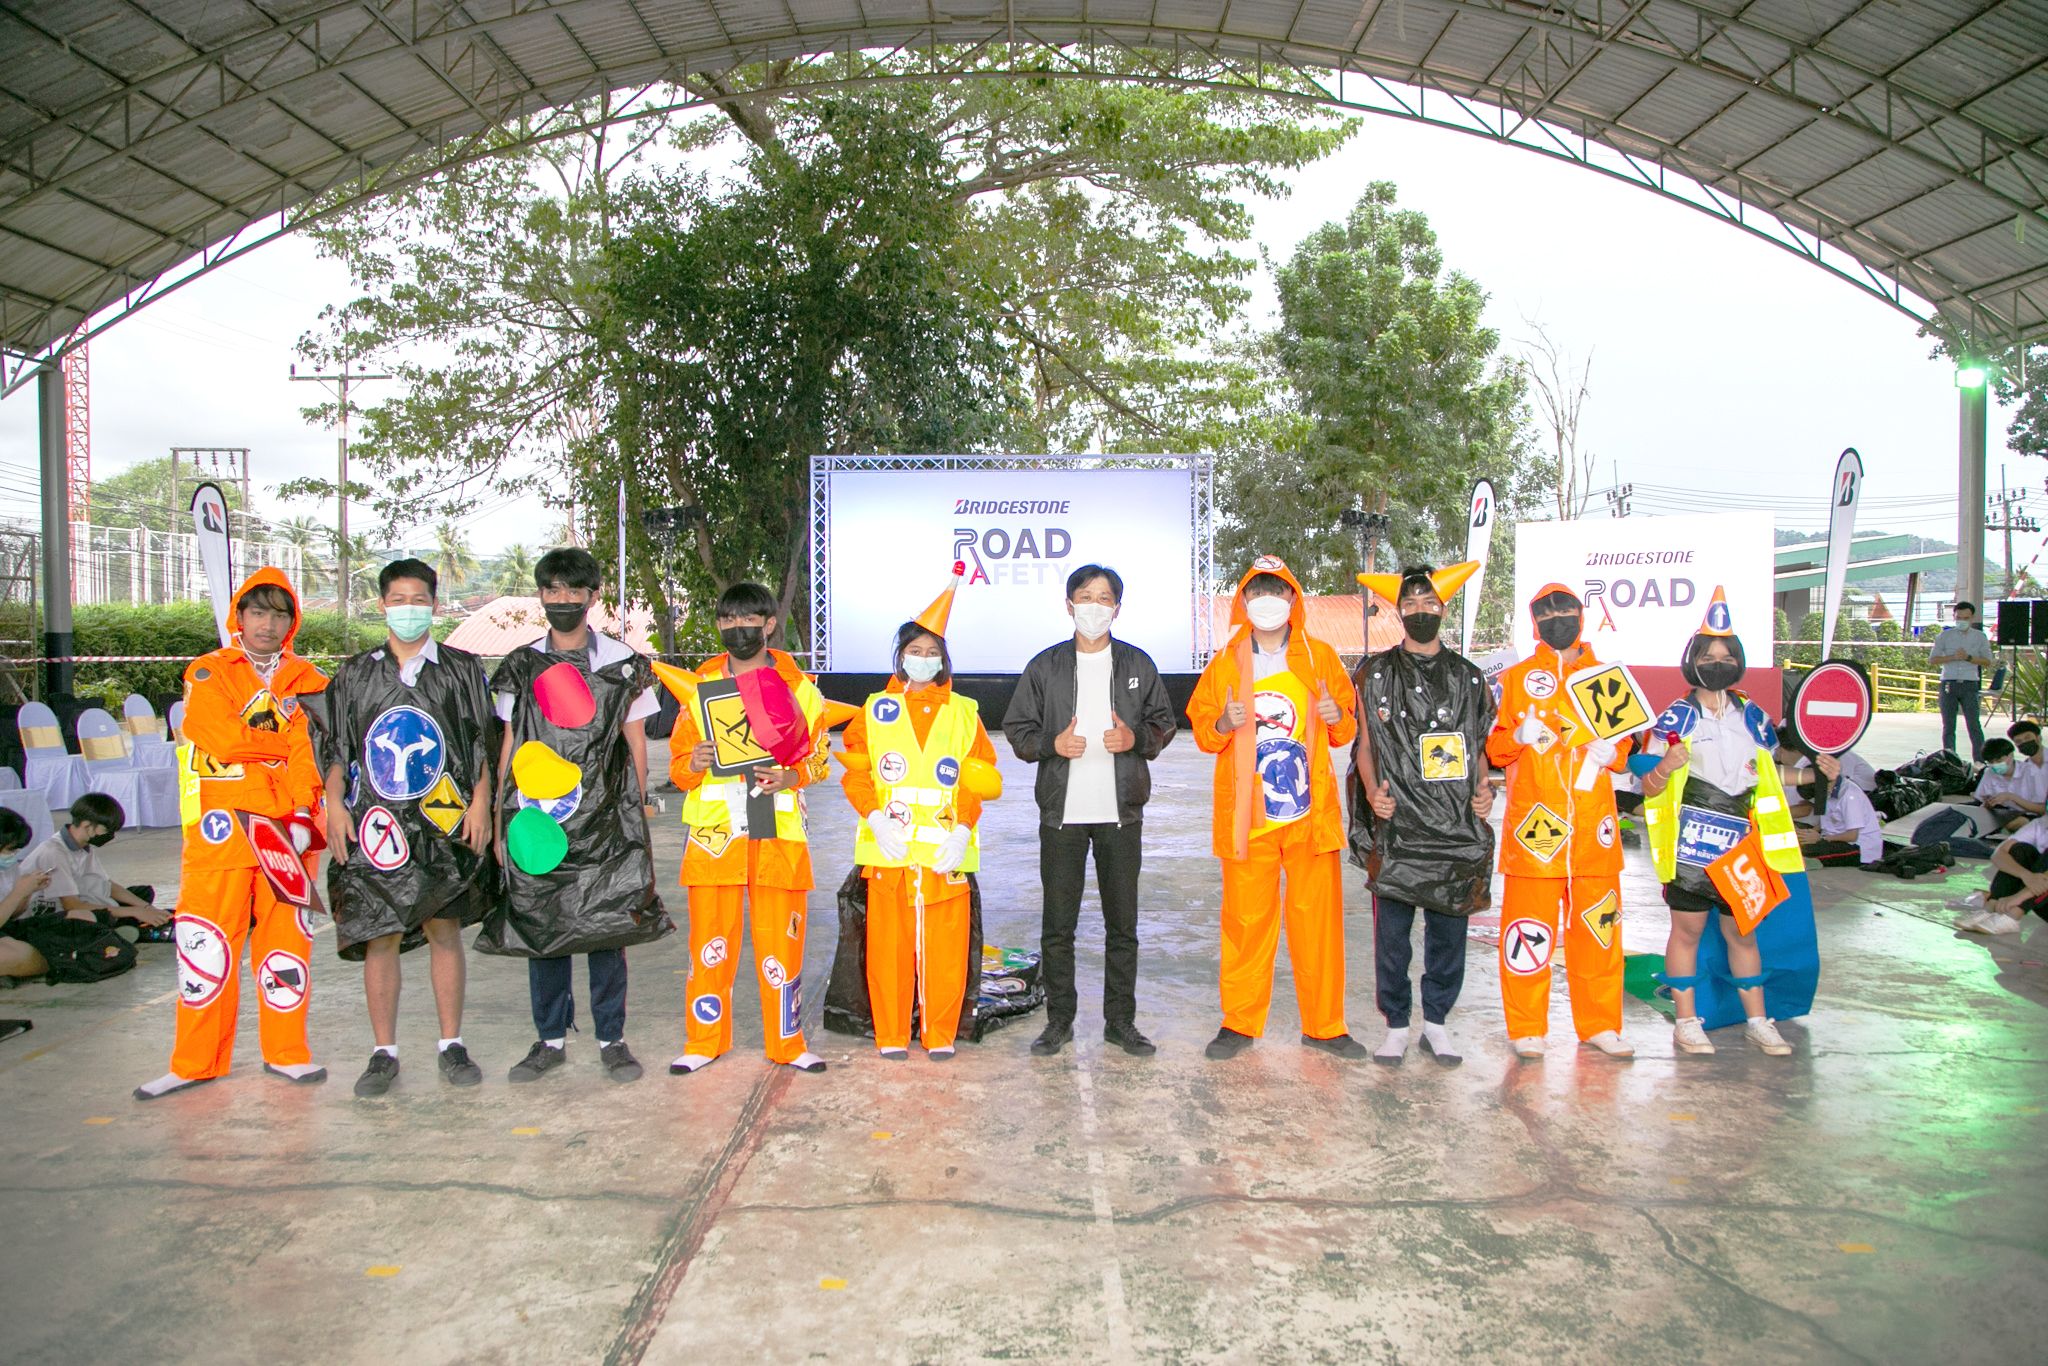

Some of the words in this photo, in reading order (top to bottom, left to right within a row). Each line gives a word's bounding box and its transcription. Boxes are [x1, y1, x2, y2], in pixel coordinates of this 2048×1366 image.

[954, 499, 1071, 515] BRIDGESTONE
[954, 528, 1072, 560] ROAD
[1585, 550, 1695, 566] BRIDGESTONE
[1584, 577, 1696, 608] ROAD
